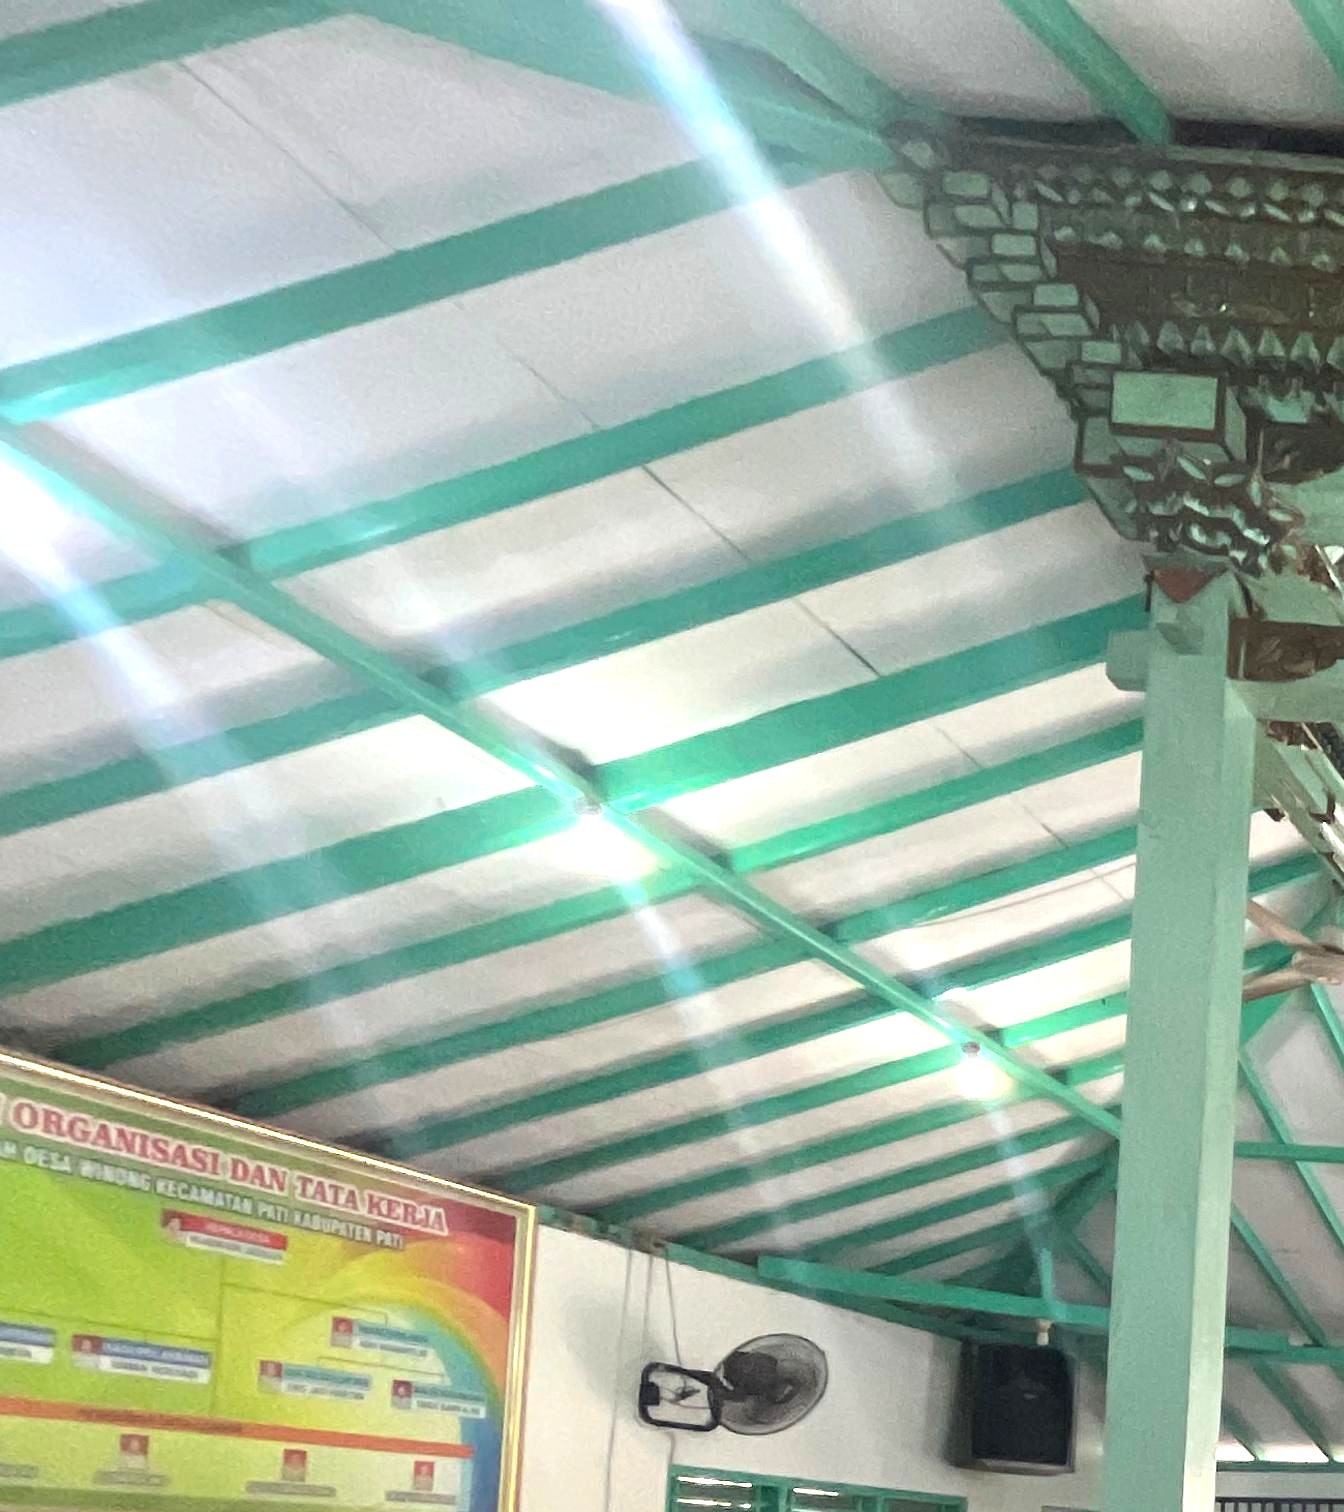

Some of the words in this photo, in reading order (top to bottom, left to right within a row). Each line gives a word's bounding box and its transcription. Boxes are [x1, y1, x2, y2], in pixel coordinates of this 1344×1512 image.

[12, 1101, 221, 1177] ORGANISASI
[229, 1156, 289, 1193] DAN
[297, 1174, 361, 1213] TATA
[365, 1191, 448, 1235] KERJA
[23, 1146, 72, 1173] DESA
[155, 1177, 252, 1214] KECAMATAN
[257, 1202, 289, 1223] PATI
[294, 1210, 372, 1243] KABUPATEN
[376, 1229, 405, 1249] PATI
